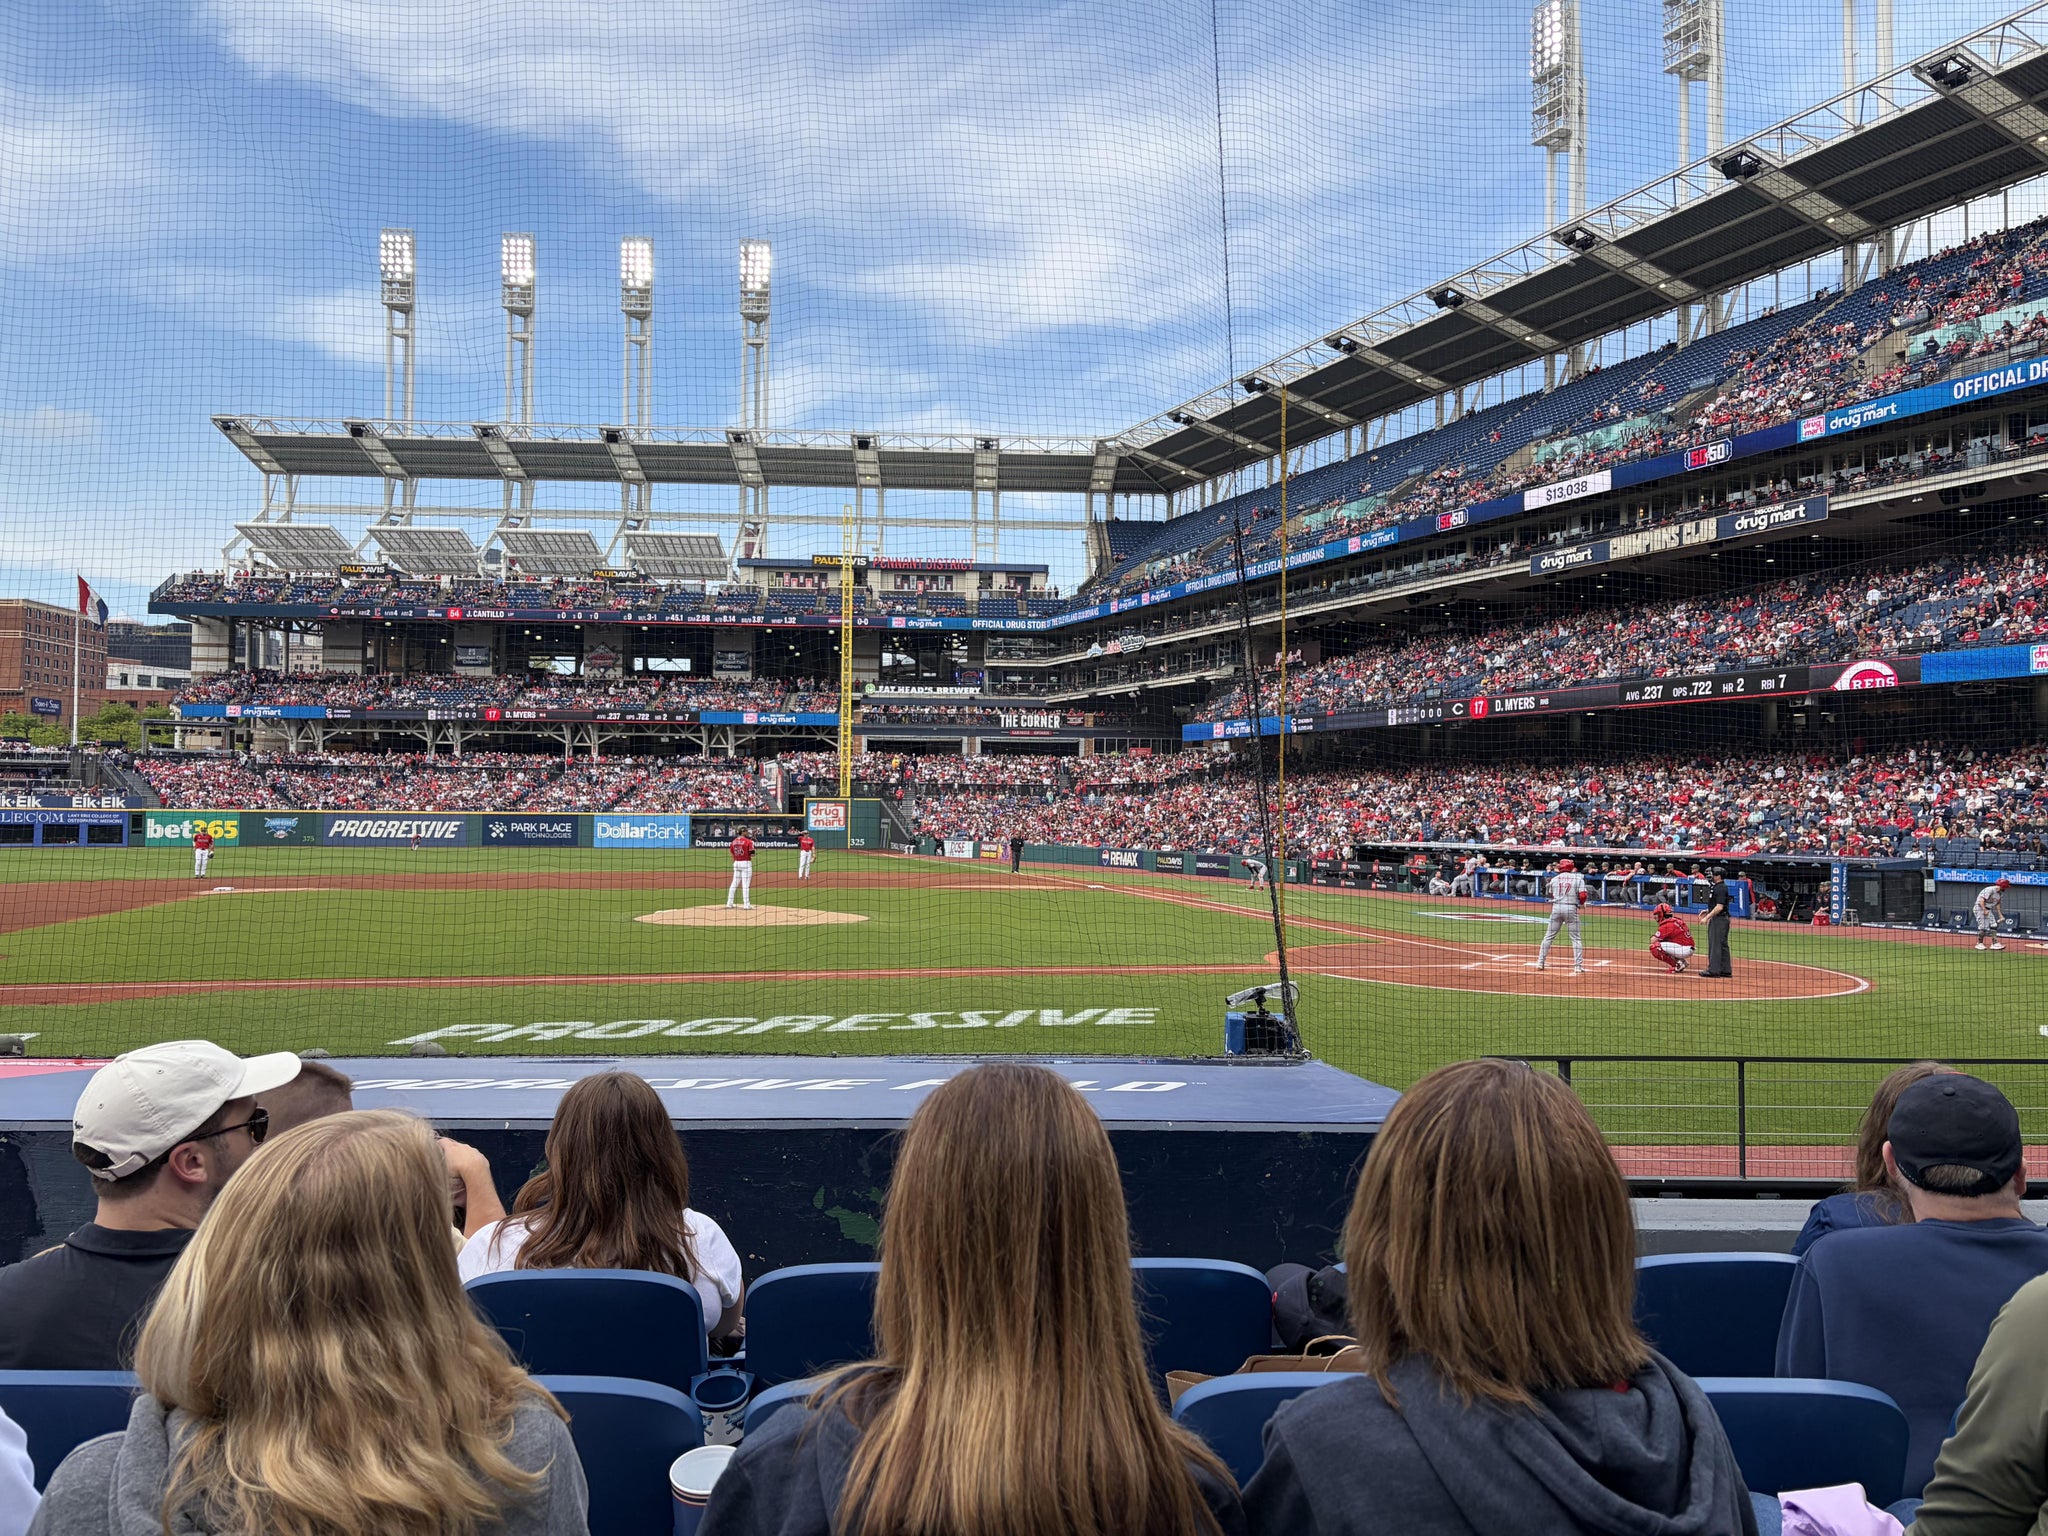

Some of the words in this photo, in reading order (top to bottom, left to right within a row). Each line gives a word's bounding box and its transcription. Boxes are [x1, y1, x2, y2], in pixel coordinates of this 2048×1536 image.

[1953, 367, 2026, 400] OFFICIAL
[2030, 360, 2048, 380] DR
[1830, 414, 1860, 430] drug
[1863, 402, 1897, 422] mart
[1848, 404, 1877, 415] DISCOUNT
[1804, 420, 1820, 430] drug
[1804, 427, 1823, 436] mart
[1546, 480, 1588, 502] $13,038
[1754, 504, 1785, 515] DISCOUNT
[1734, 514, 1768, 530] drug
[1770, 504, 1806, 524] mart
[1682, 518, 1718, 544] CLUB
[1362, 538, 1378, 548] drug
[1378, 532, 1394, 544] mart
[872, 556, 924, 569] PENNANT
[926, 558, 974, 570] DISTRICT
[1540, 556, 1564, 568] drug
[1566, 548, 1592, 564] mart
[1208, 578, 1222, 587] DRUG
[1222, 572, 1238, 584] STOR
[1247, 566, 1256, 577] THE
[1258, 558, 1289, 574] CLEVELAD
[1290, 548, 1324, 566] GUARDIANS
[908, 619, 924, 628] drug
[925, 619, 942, 627] mart
[972, 620, 1005, 629] OFFICIAL
[897, 686, 933, 694] HEAD'S
[1626, 691, 1640, 701] AVG
[1641, 685, 1664, 700] .237
[1672, 686, 1688, 697] OPS
[1689, 680, 1712, 696] .722
[1722, 683, 1734, 693] HR
[1736, 678, 1745, 692] 2
[1761, 679, 1775, 690] RBI
[1778, 674, 1786, 688] 7
[1852, 676, 1895, 690] REDS
[243, 708, 261, 716] drug
[1474, 700, 1484, 714] 17
[1495, 700, 1504, 712] D.
[1505, 697, 1535, 711] MYERS
[760, 715, 777, 724] drug
[1000, 714, 1018, 728] THE
[1020, 715, 1060, 728] CORNER
[1226, 725, 1240, 736] drug
[811, 803, 840, 819] drug
[146, 818, 238, 839] bet365
[511, 823, 536, 832] PARK
[539, 823, 572, 832] PLACE
[814, 816, 846, 827] mart
[328, 820, 462, 838] PROGRESSIVE
[696, 840, 732, 848] Dumpster
[2002, 874, 2048, 885] DollarBan
[387, 1008, 1160, 1045] PROGRESSIVE
[889, 1079, 1187, 1092] FLD
